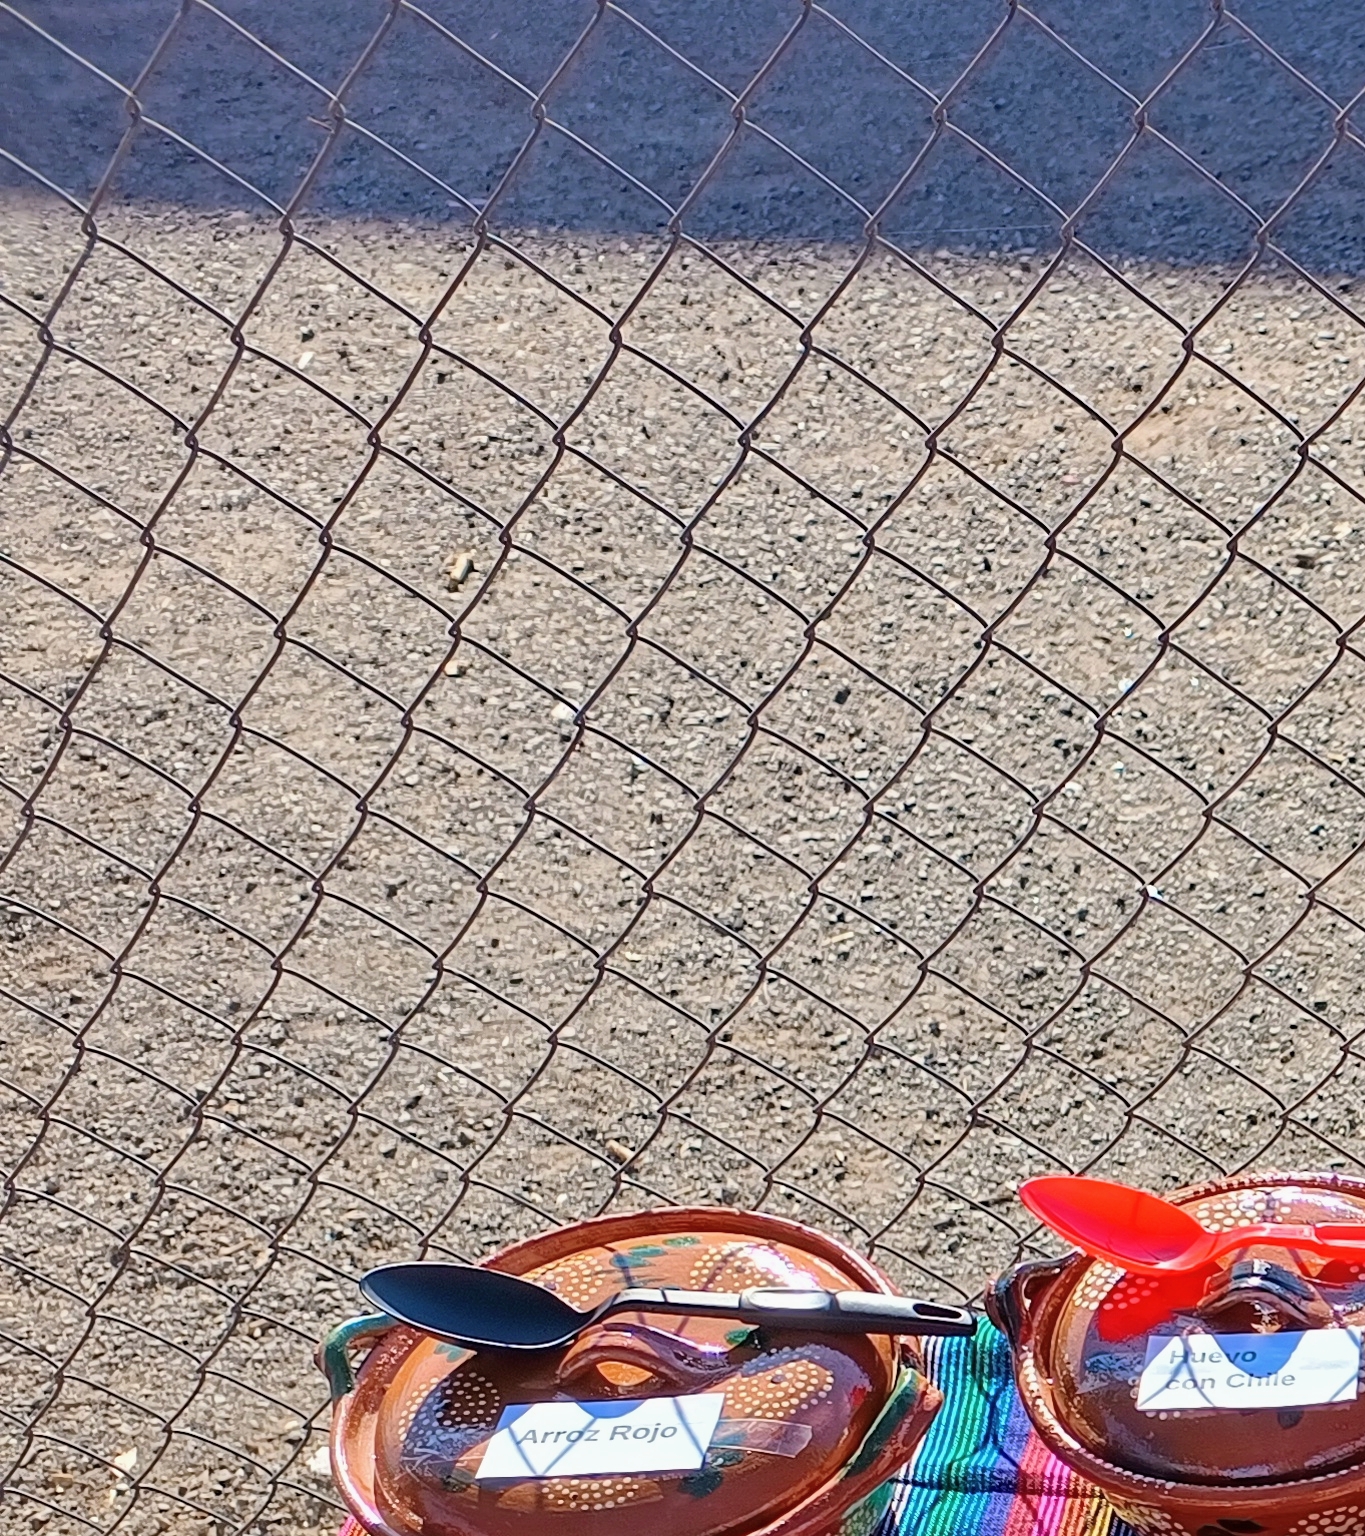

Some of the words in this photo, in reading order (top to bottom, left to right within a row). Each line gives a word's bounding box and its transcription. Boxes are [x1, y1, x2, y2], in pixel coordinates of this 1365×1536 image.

[1169, 1350, 1258, 1365] Huevo
[1165, 1373, 1216, 1390] con
[1226, 1373, 1297, 1389] Chile
[519, 1426, 598, 1445] Arroz
[609, 1423, 678, 1444] Rojo
